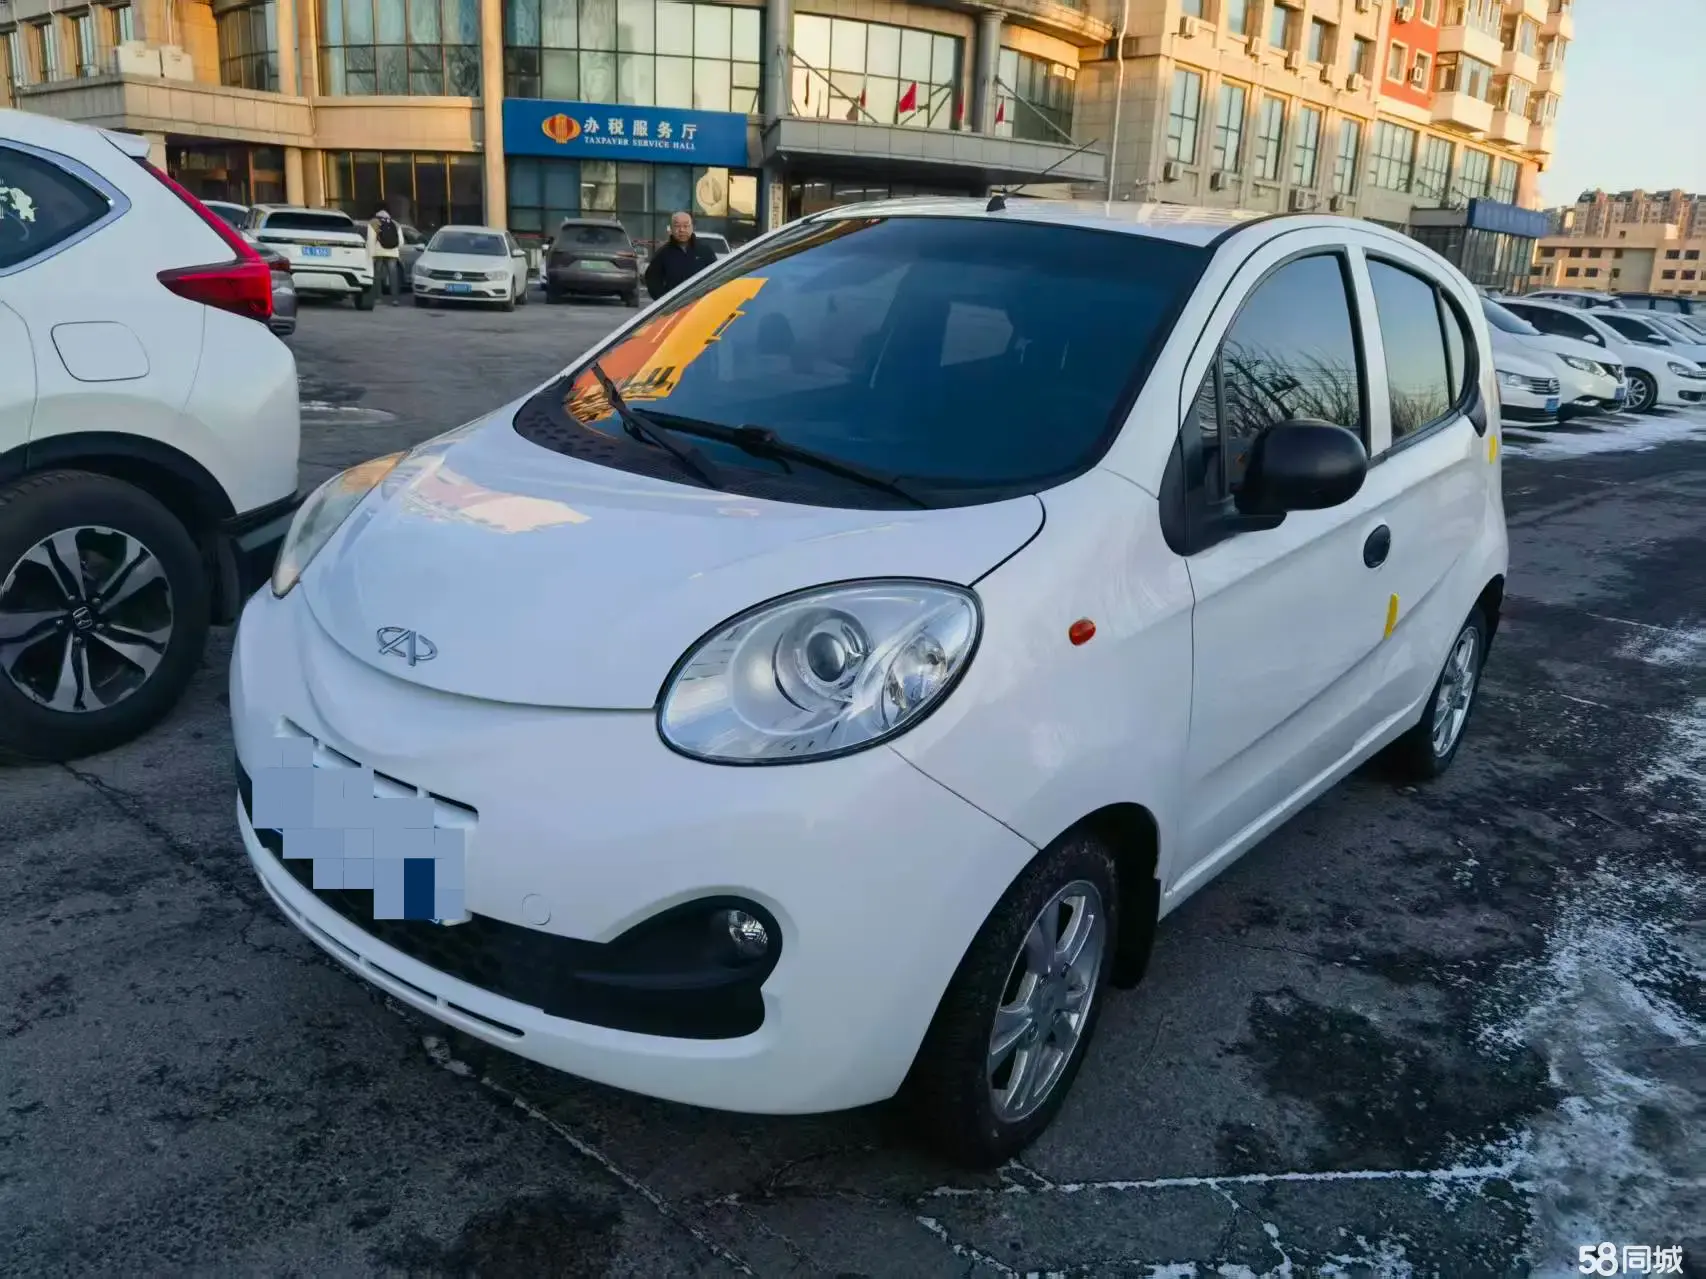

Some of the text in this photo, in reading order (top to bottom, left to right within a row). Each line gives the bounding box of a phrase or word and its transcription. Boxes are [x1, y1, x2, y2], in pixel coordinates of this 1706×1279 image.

[583, 116, 697, 140] 办税服务厅
[584, 136, 695, 150] TAXPAYER SERVICE HALL
